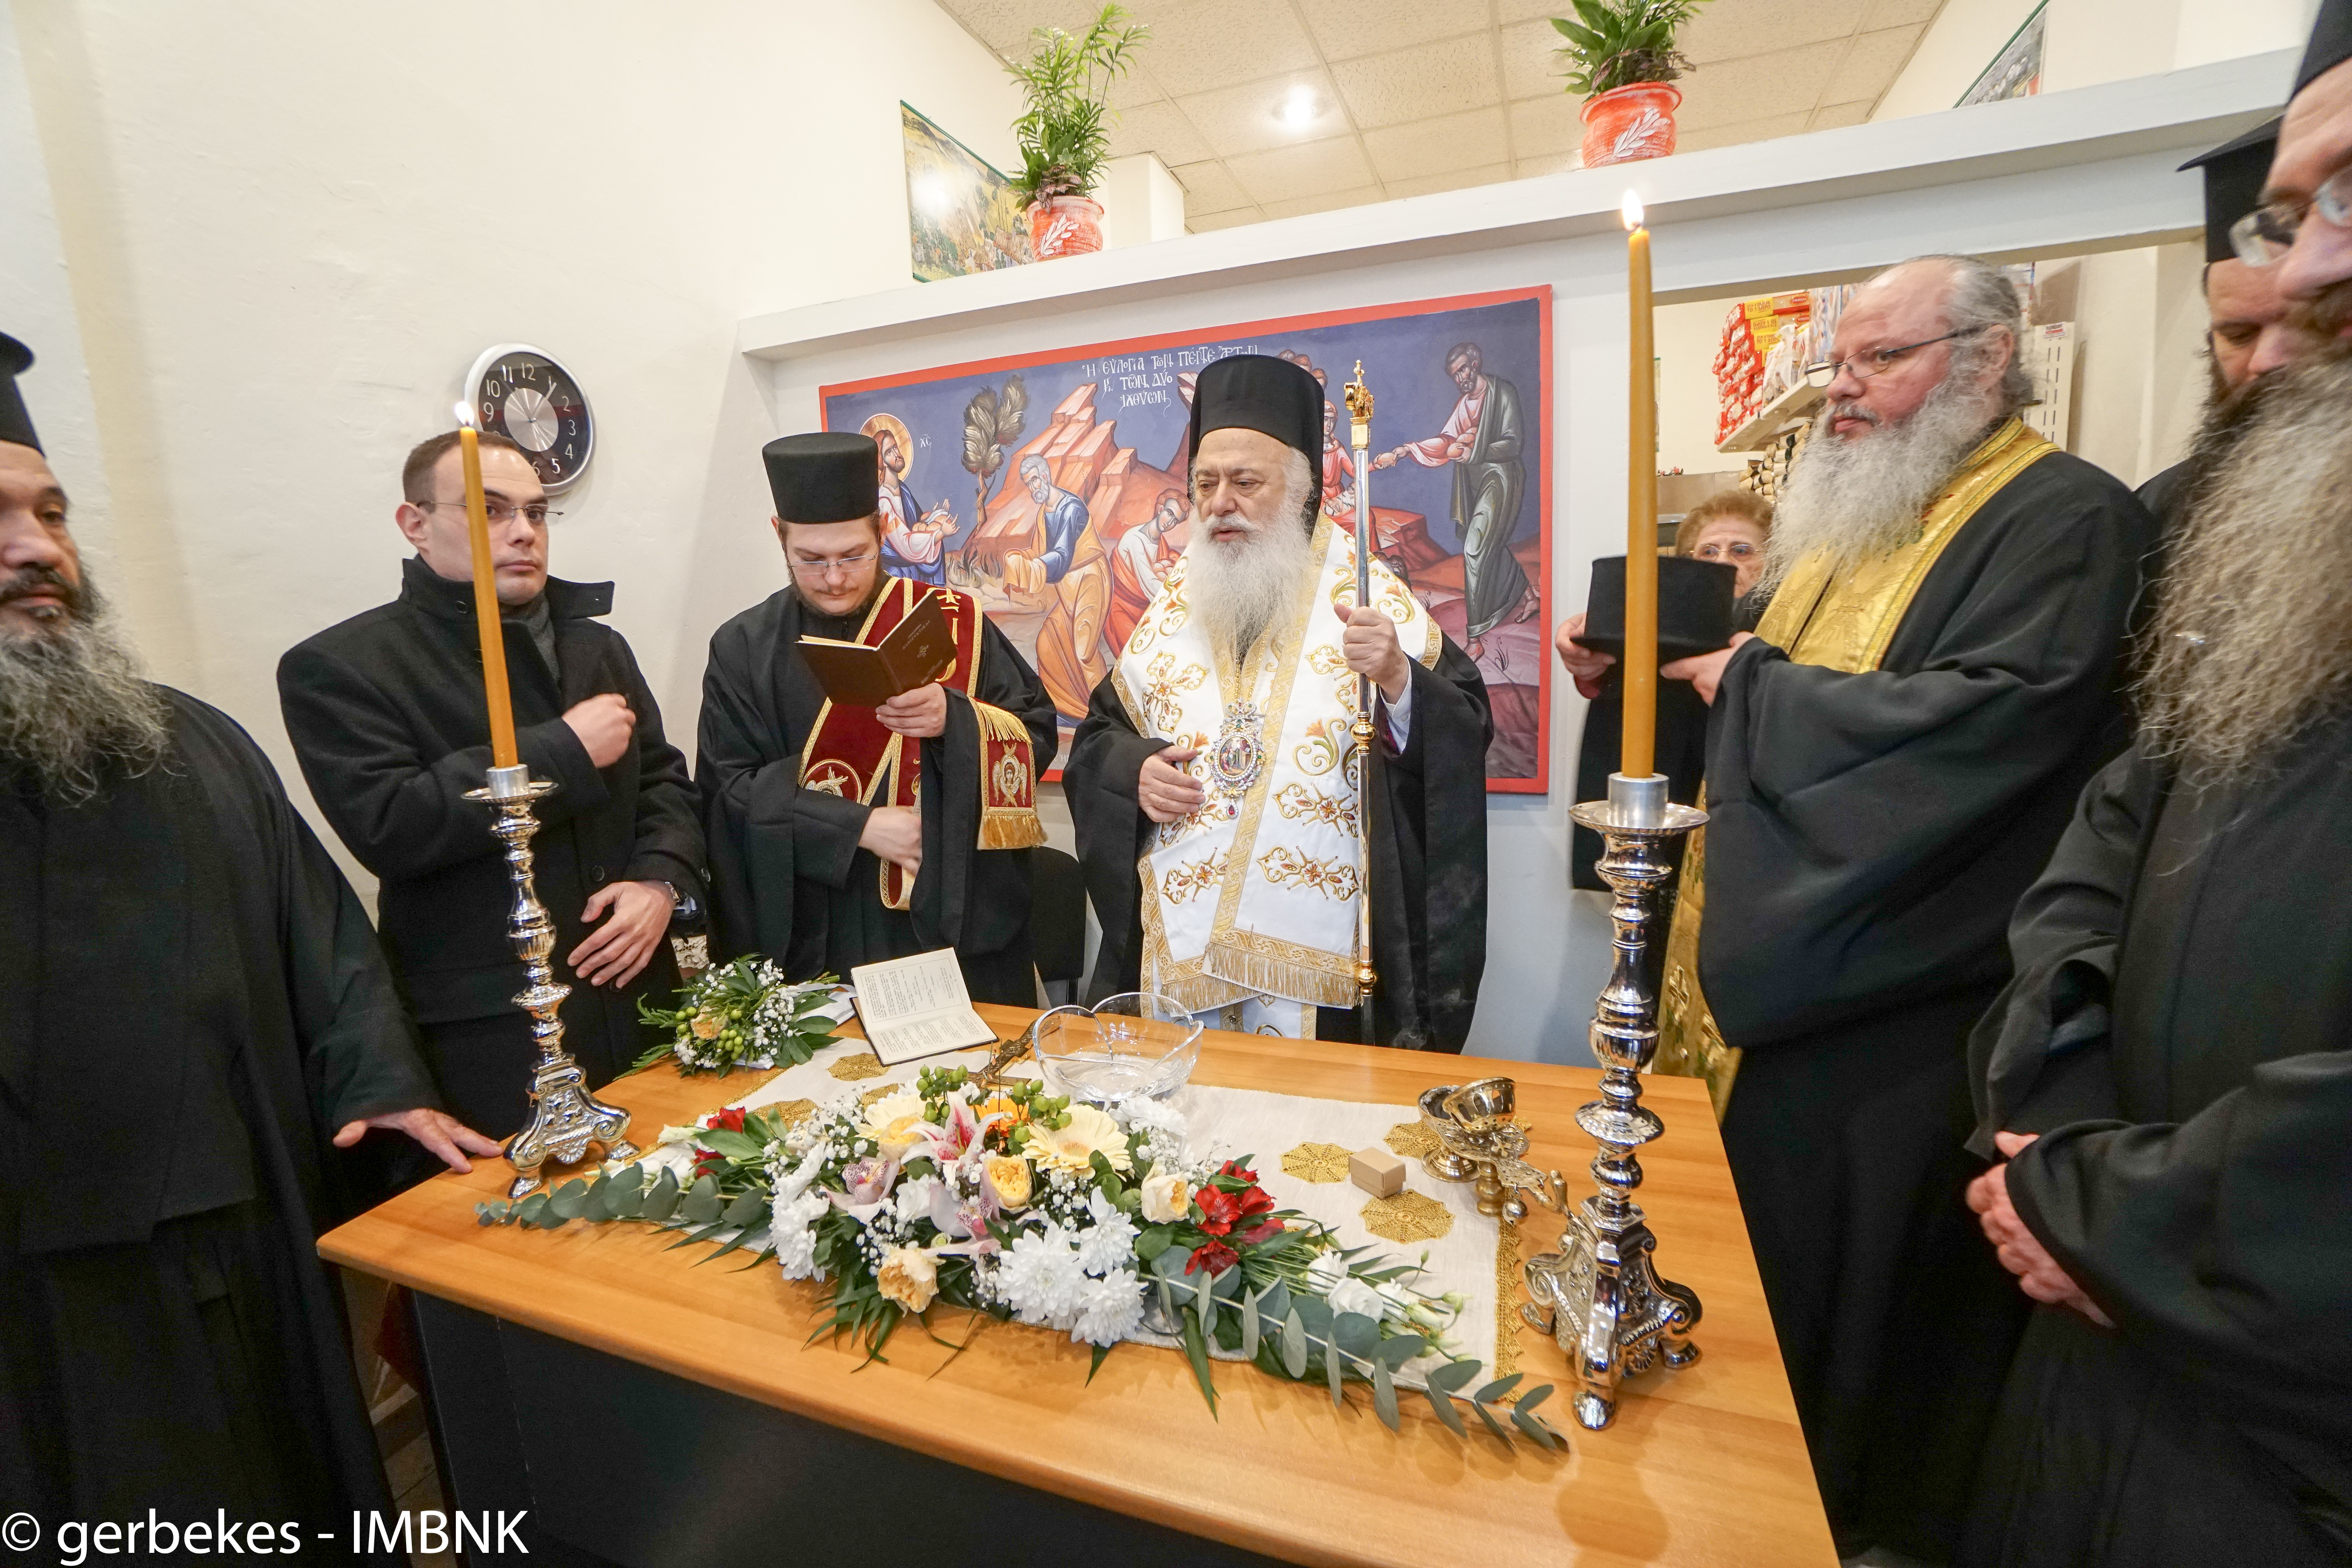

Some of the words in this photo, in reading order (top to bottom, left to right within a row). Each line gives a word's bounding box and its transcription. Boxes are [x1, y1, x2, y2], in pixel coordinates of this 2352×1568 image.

[502, 364, 513, 383] 11
[522, 363, 536, 381] 12
[487, 379, 500, 397] 10
[483, 402, 494, 422] 9
[561, 396, 571, 412] 2
[568, 420, 576, 436] 3
[565, 444, 573, 459] 4
[551, 458, 560, 474] 5
